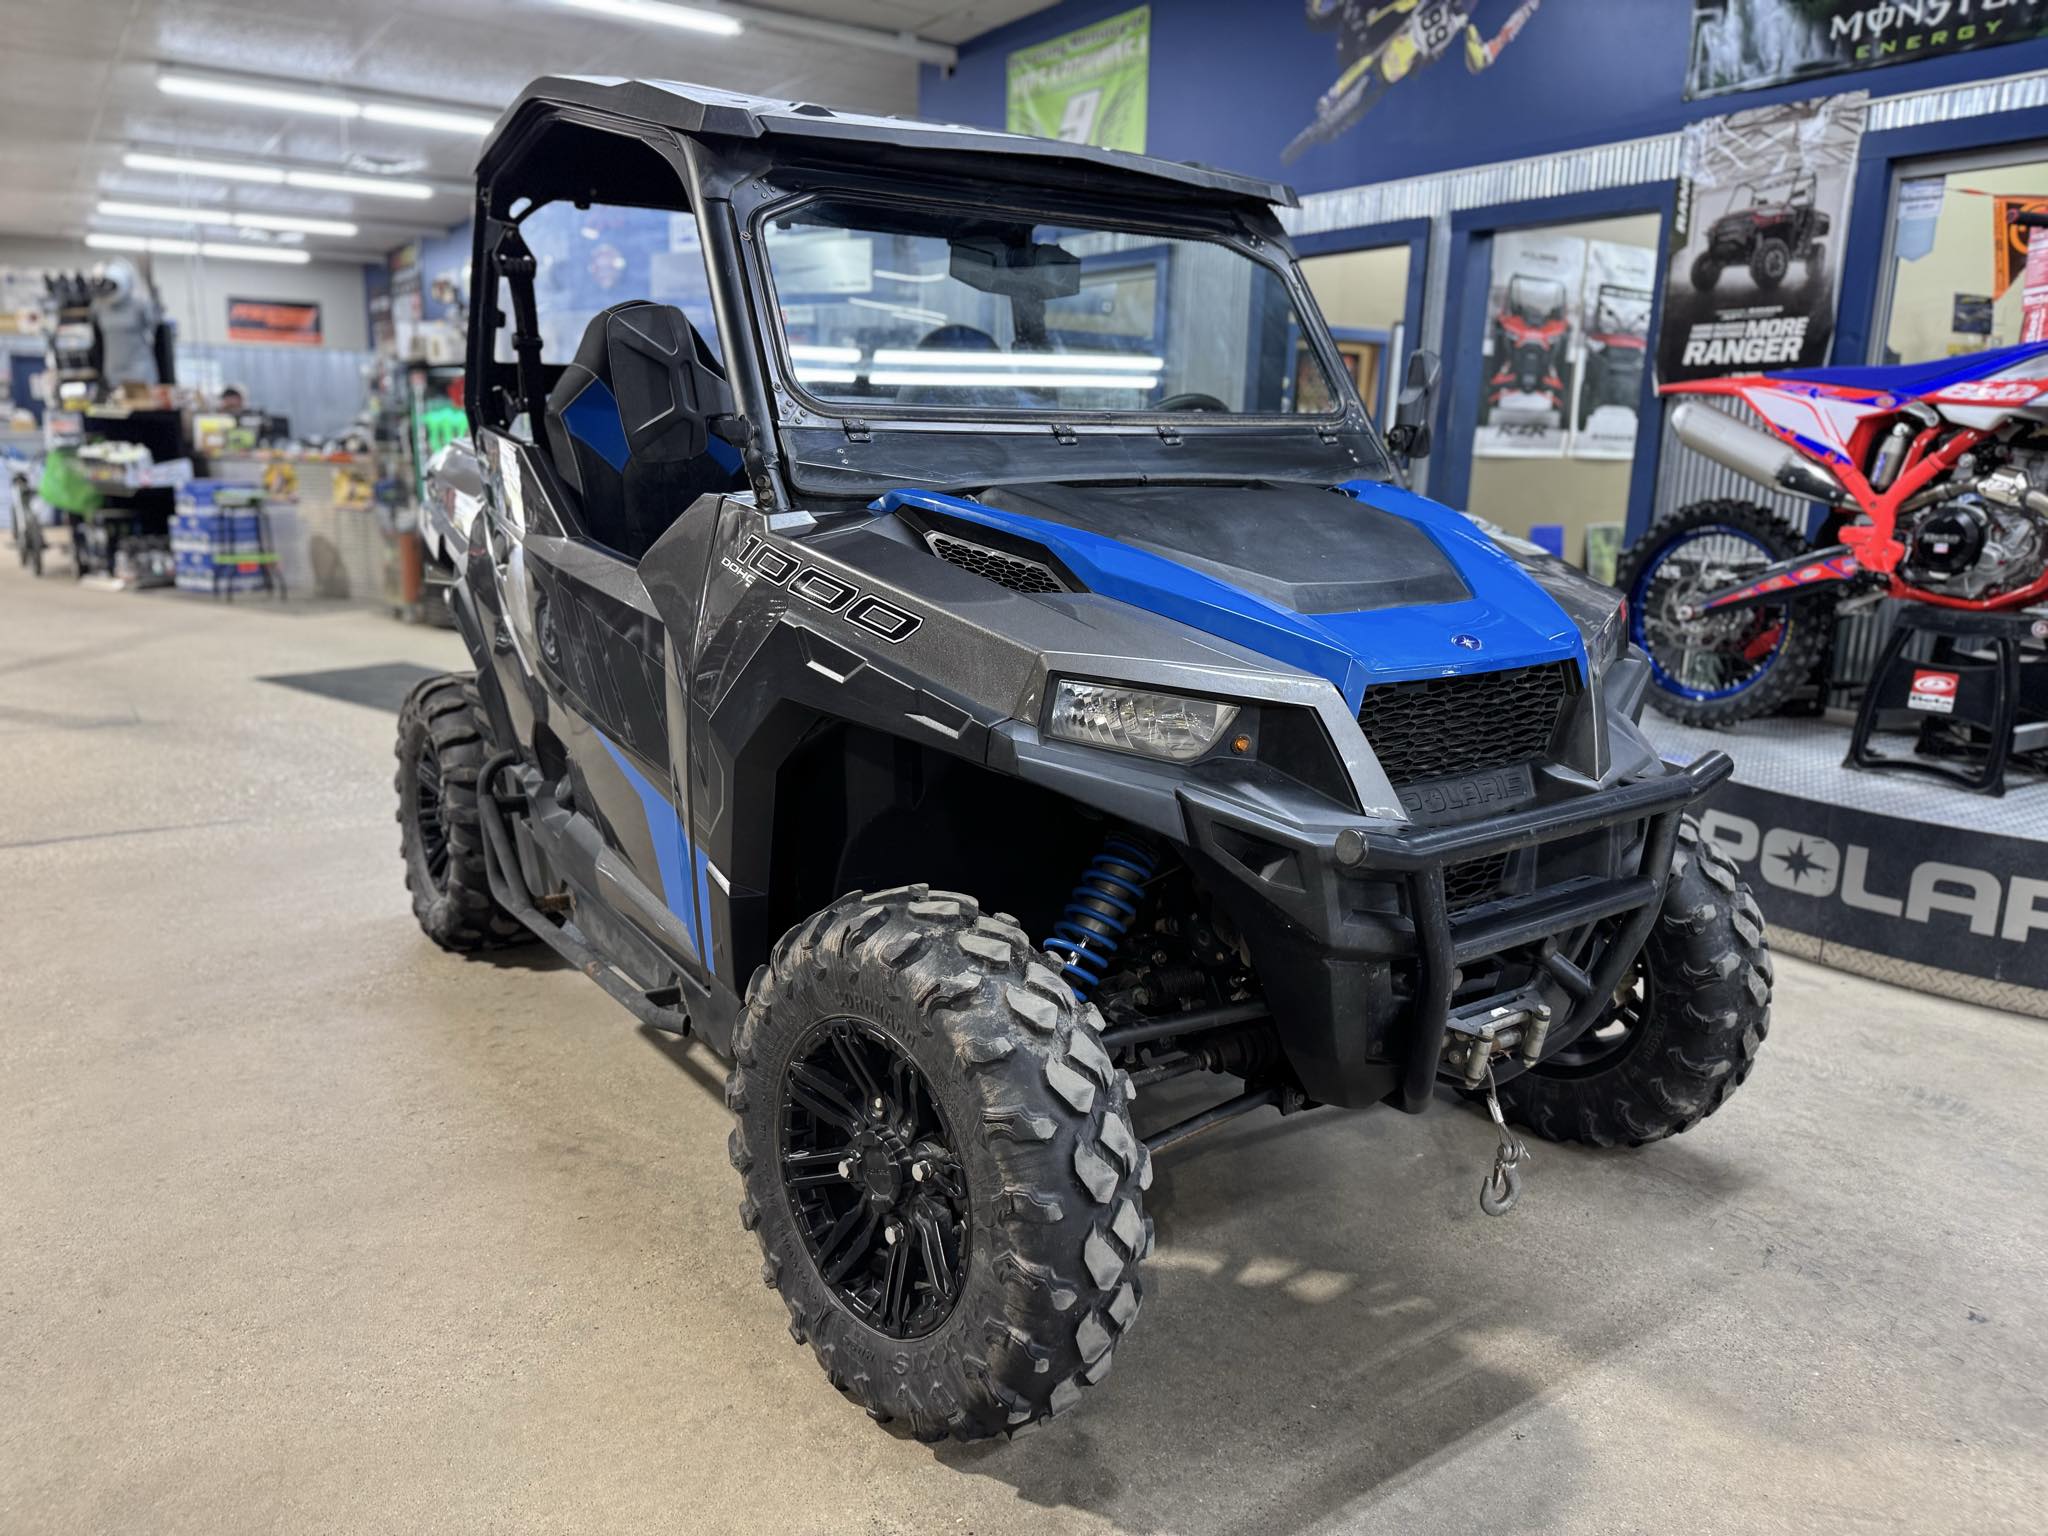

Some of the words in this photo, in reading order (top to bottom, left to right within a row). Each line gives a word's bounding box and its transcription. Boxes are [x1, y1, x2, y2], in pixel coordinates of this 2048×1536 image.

[1855, 19, 2003, 59] ENERGY
[1746, 316, 1809, 337] MORE
[1682, 337, 1804, 366] RANGER
[721, 556, 756, 588] DOHC
[735, 534, 925, 645] 1000
[1400, 772, 1525, 814] POLARIS
